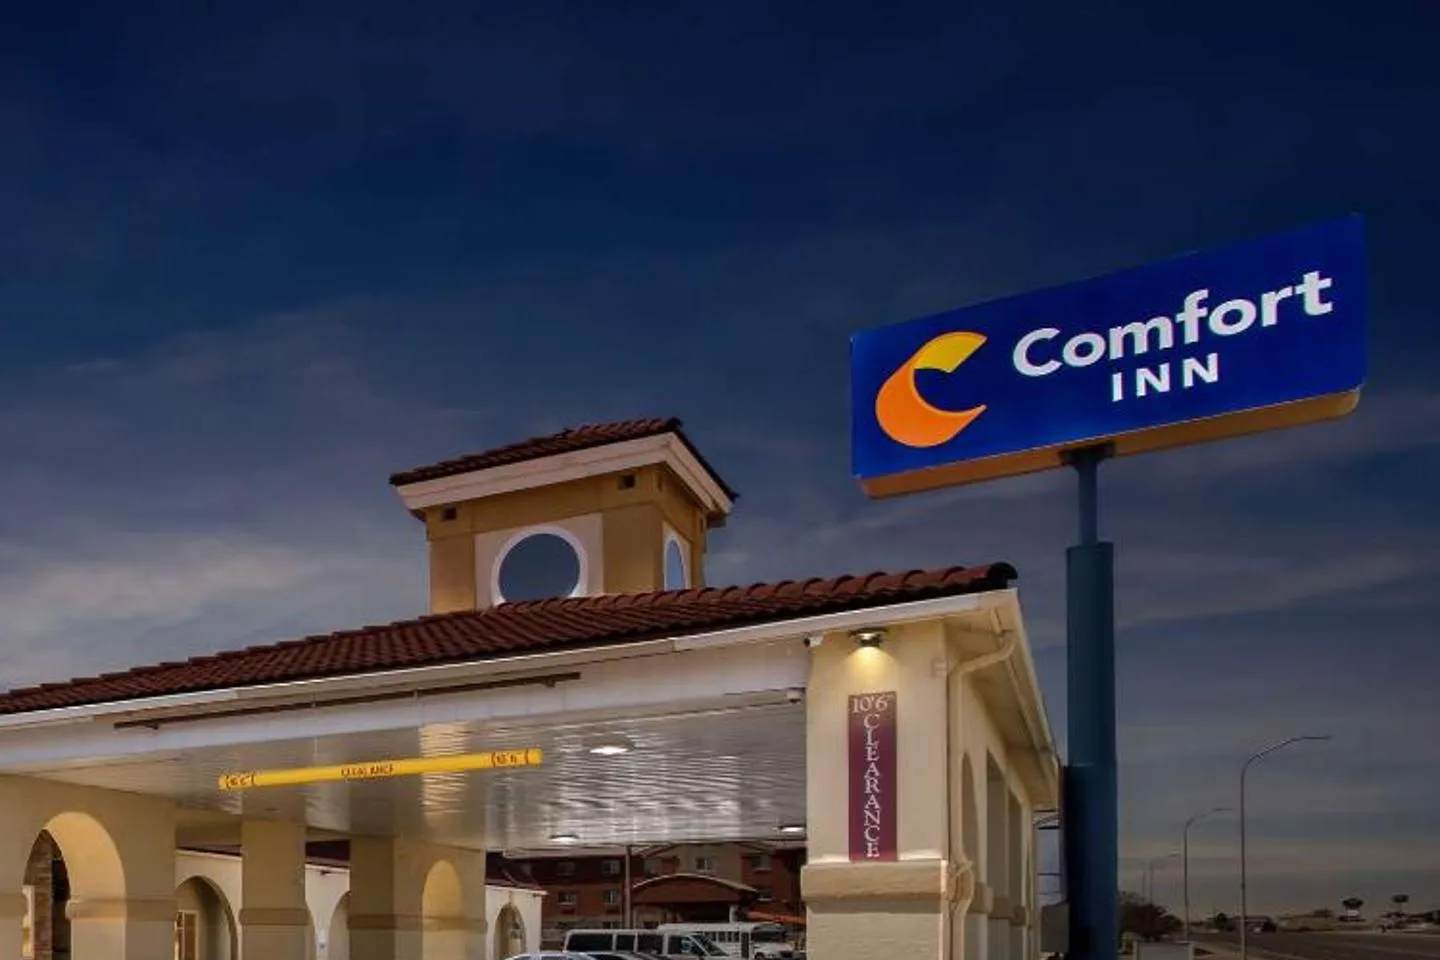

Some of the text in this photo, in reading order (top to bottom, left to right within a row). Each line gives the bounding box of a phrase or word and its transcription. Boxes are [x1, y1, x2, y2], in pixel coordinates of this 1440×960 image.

[1013, 271, 1333, 377] Comfort
[1111, 353, 1219, 402] INN
[863, 713, 881, 858] CLEARANCE
